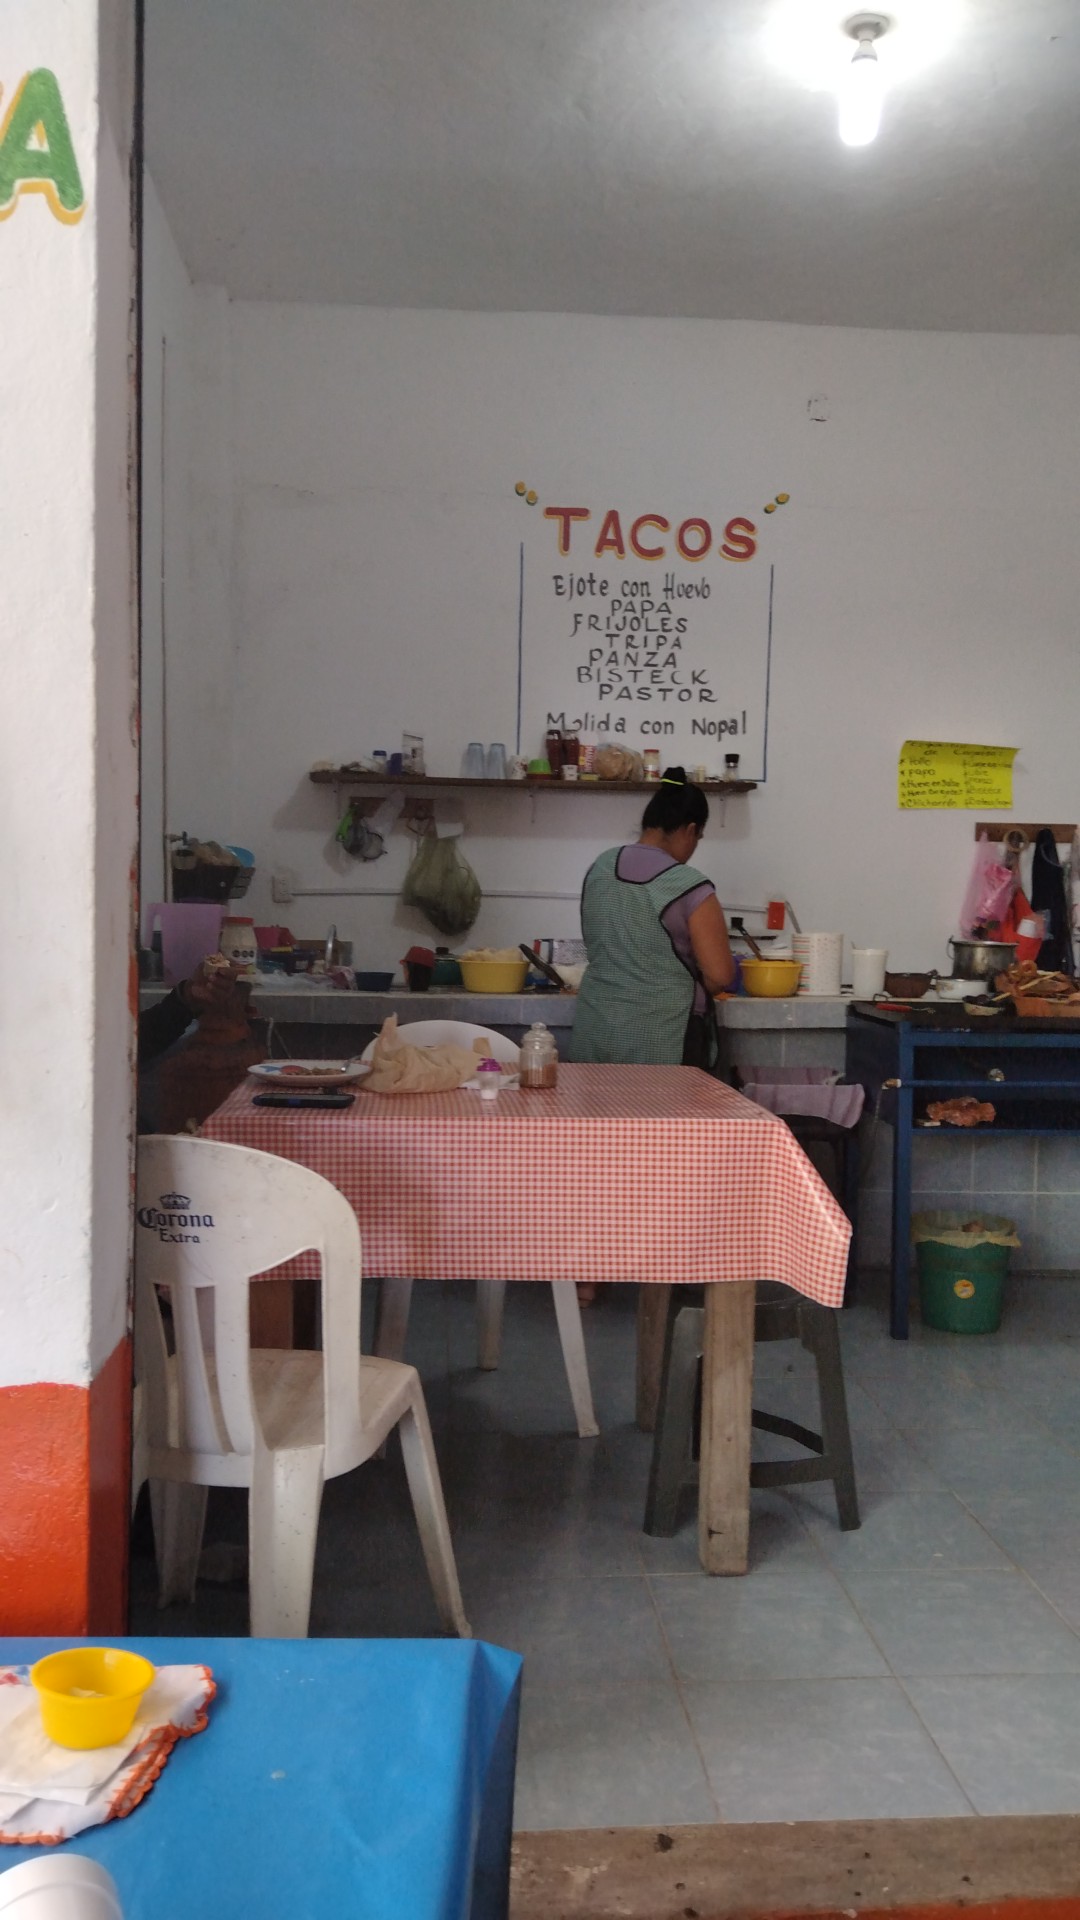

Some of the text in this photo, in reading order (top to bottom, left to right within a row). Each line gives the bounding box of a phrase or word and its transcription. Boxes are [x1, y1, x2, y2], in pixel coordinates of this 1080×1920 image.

[543, 506, 758, 562] TACOS
[552, 573, 711, 600] Ejote con Huevo
[610, 599, 673, 618] PAPA
[569, 613, 688, 637] FRIJOLES
[605, 633, 683, 650] TRIPA
[589, 649, 678, 669] PANZA
[576, 666, 709, 685] BISTECK
[599, 684, 718, 703] PASTOR
[546, 710, 748, 742] Molida con Nopal
[138, 1206, 215, 1230] Corona
[159, 1228, 201, 1244] Extra
